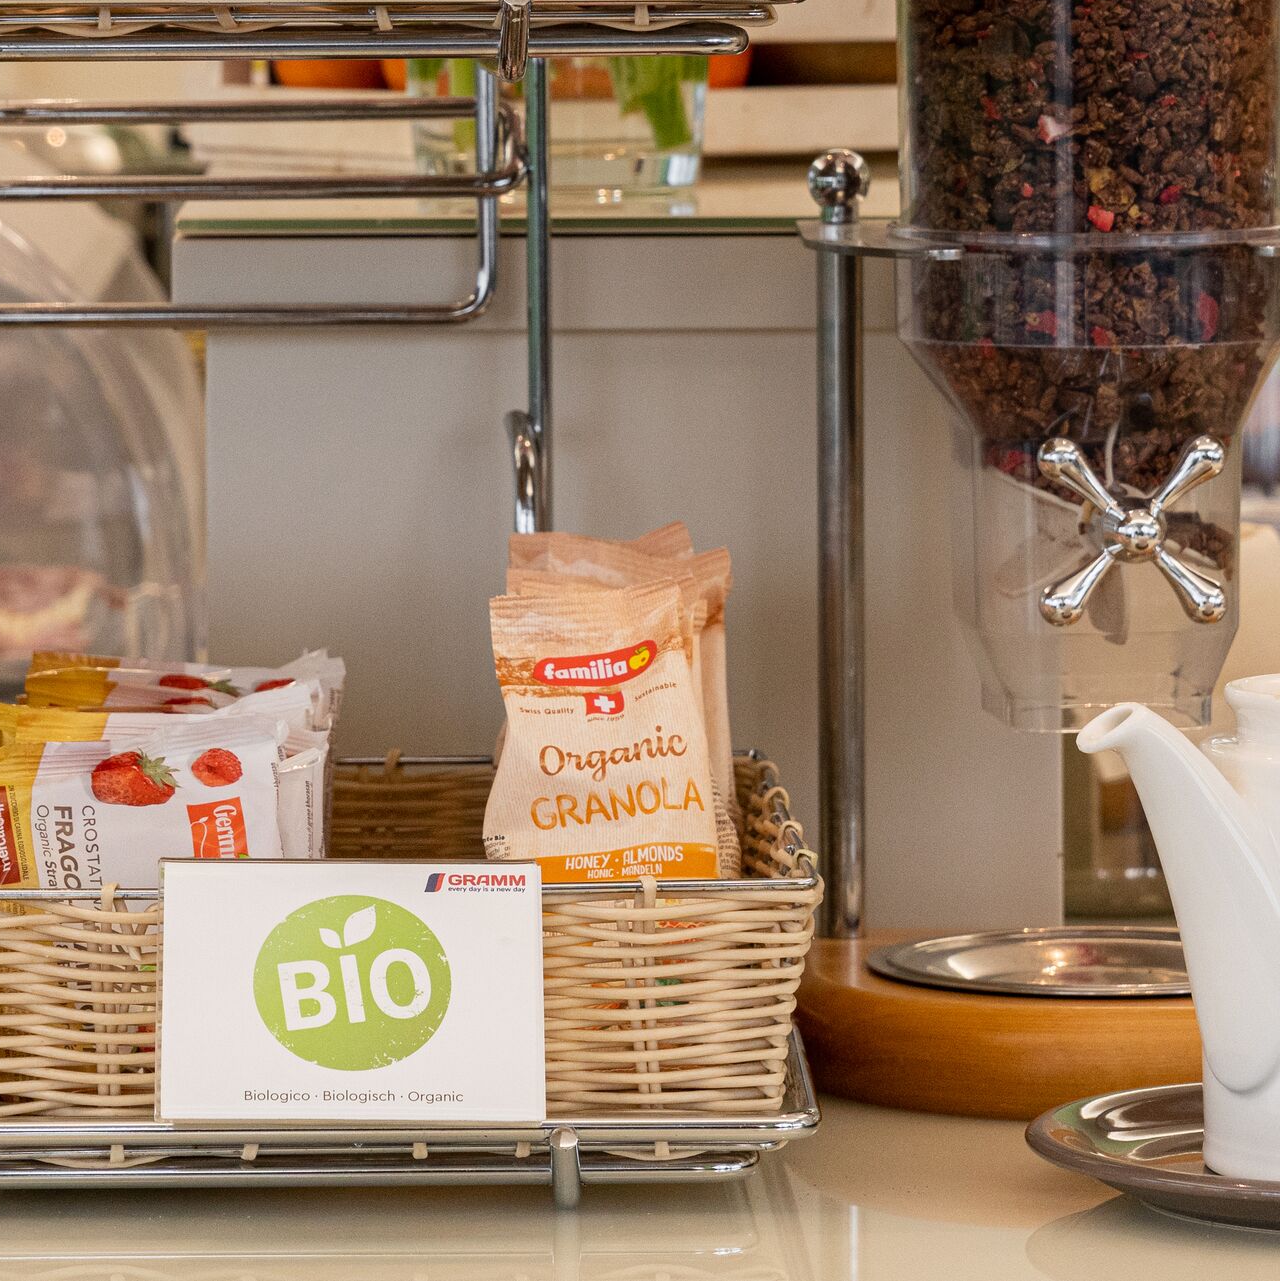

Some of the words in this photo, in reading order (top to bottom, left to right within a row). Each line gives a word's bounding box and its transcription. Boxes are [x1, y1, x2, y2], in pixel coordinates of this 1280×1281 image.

[544, 657, 628, 680] familia
[544, 707, 574, 715] Quality
[539, 725, 687, 782] Organic
[530, 777, 705, 830] GRANOLA
[35, 805, 54, 858] Organic
[565, 853, 611, 870] HONEY
[622, 845, 684, 866] ALMONDS
[448, 874, 526, 887] GRAMM
[587, 868, 614, 879] HONIG
[621, 863, 663, 877] MANDELN
[277, 947, 432, 1032] BIO
[243, 1090, 311, 1103] Biologico
[322, 1089, 396, 1103] Biologisch
[407, 1090, 464, 1104] Organic
